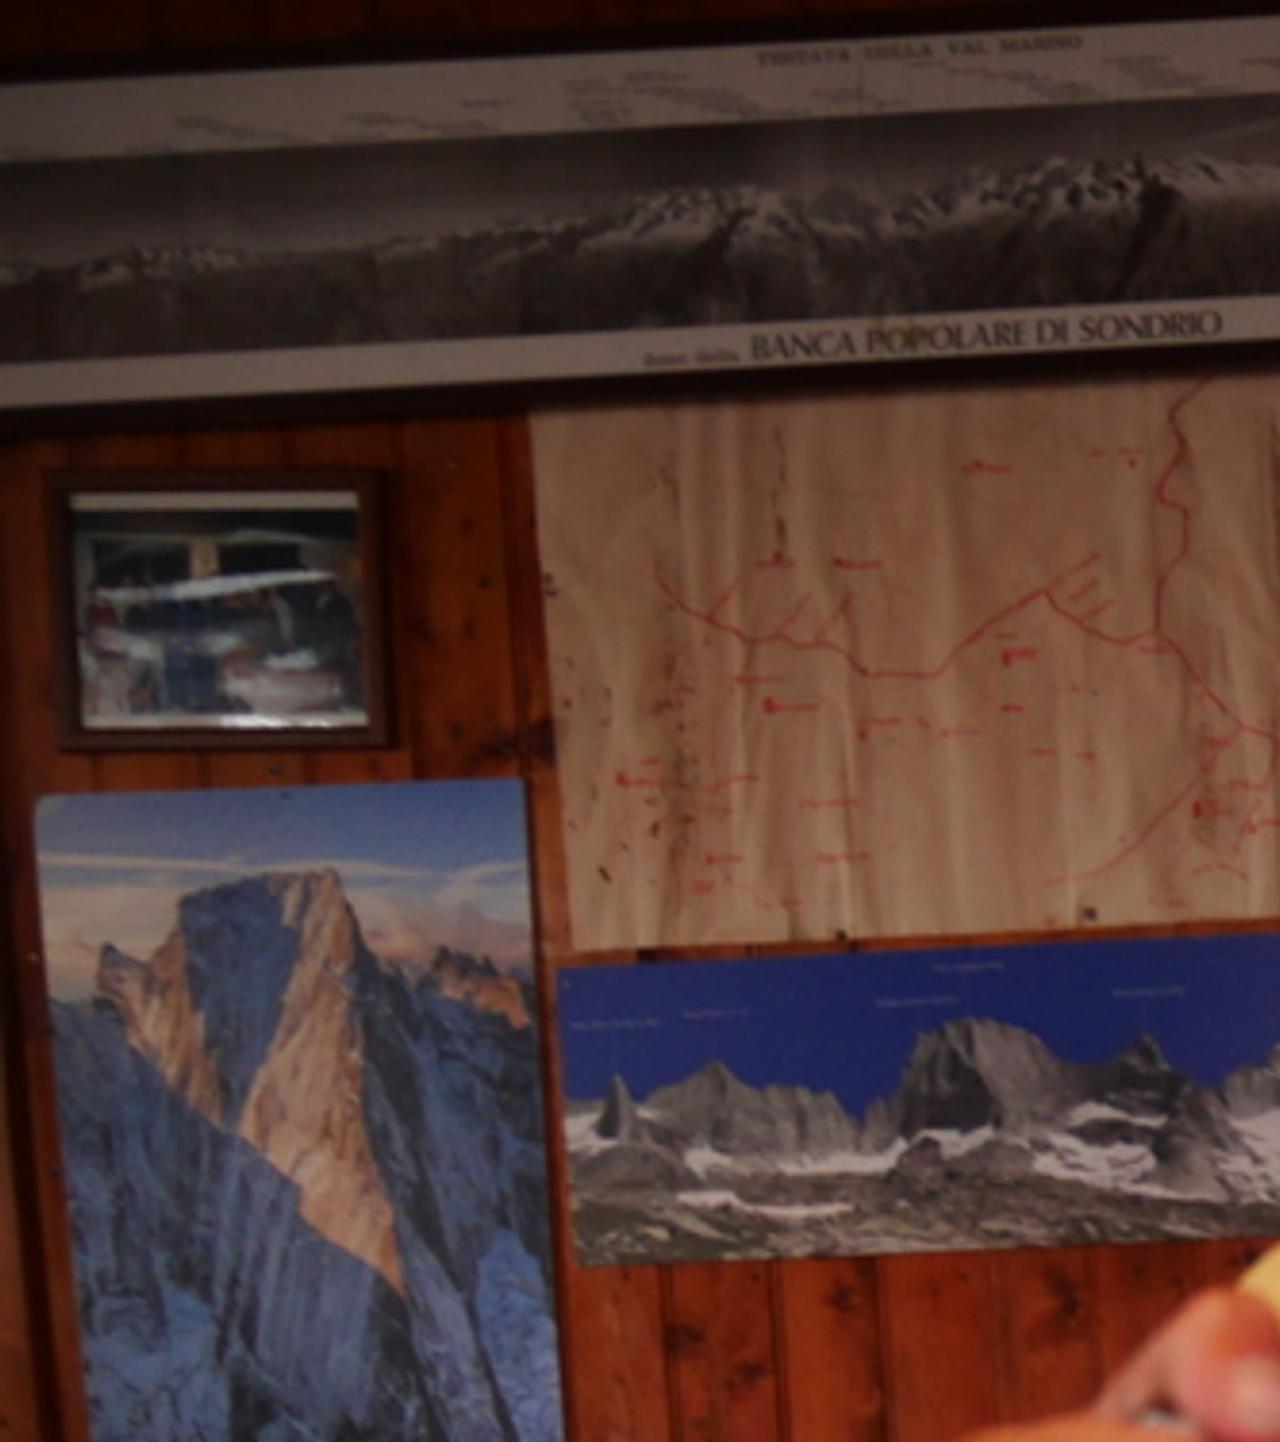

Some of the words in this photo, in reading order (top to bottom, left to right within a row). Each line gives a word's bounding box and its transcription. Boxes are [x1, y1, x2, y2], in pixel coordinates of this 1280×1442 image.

[947, 39, 988, 56] VAL
[750, 331, 857, 362] BANCA
[866, 319, 1027, 355] POPOLARE
[1036, 317, 1070, 343] DI
[1079, 308, 1224, 341] SONDRIO
